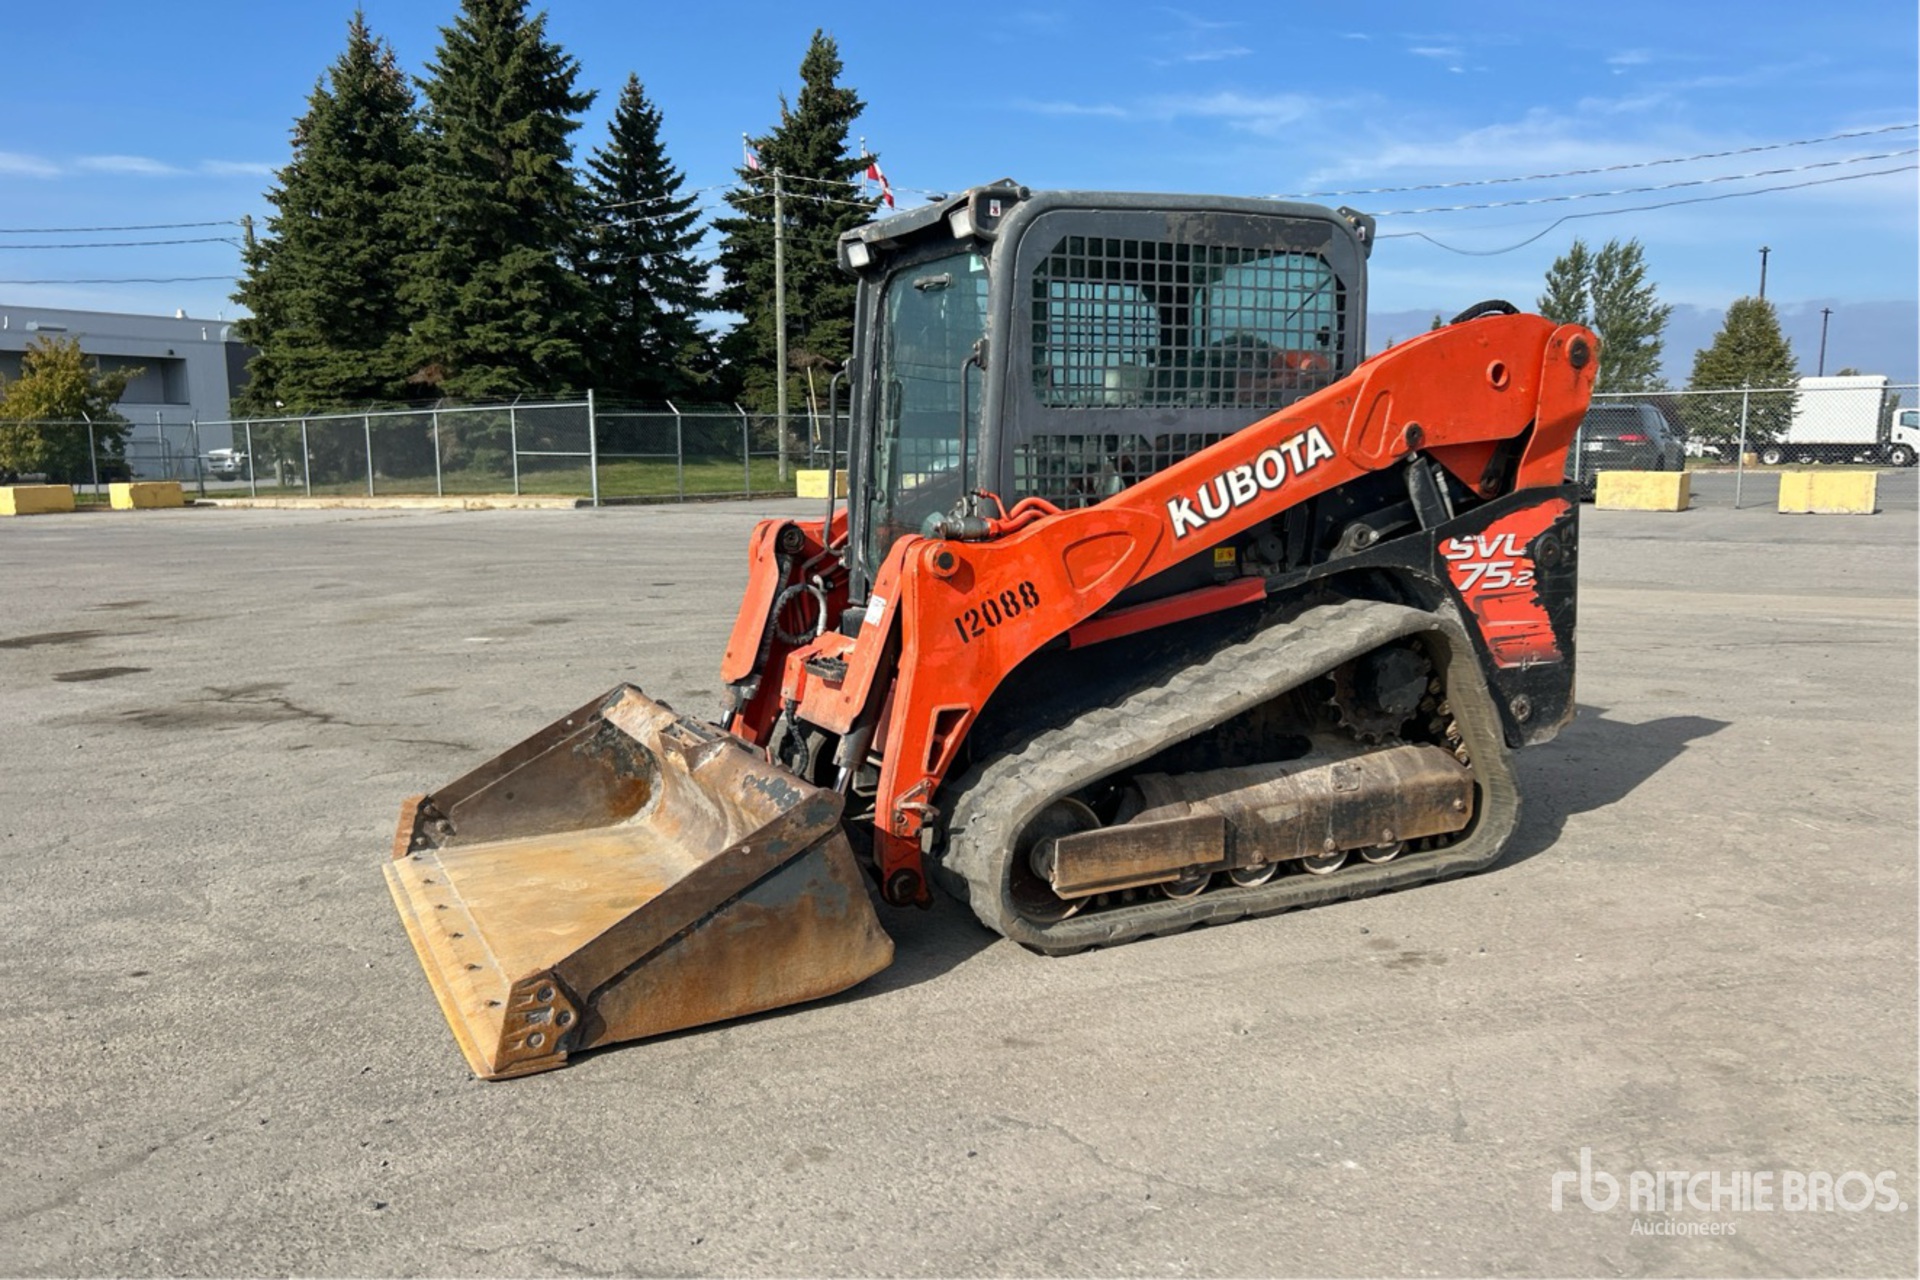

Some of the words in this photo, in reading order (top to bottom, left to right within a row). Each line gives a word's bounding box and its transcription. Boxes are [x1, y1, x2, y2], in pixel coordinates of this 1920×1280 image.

[1166, 425, 1335, 539] KUBOTA
[1445, 533, 1528, 560] SVL
[1458, 561, 1535, 591] 75-2
[954, 580, 1040, 644] 12088
